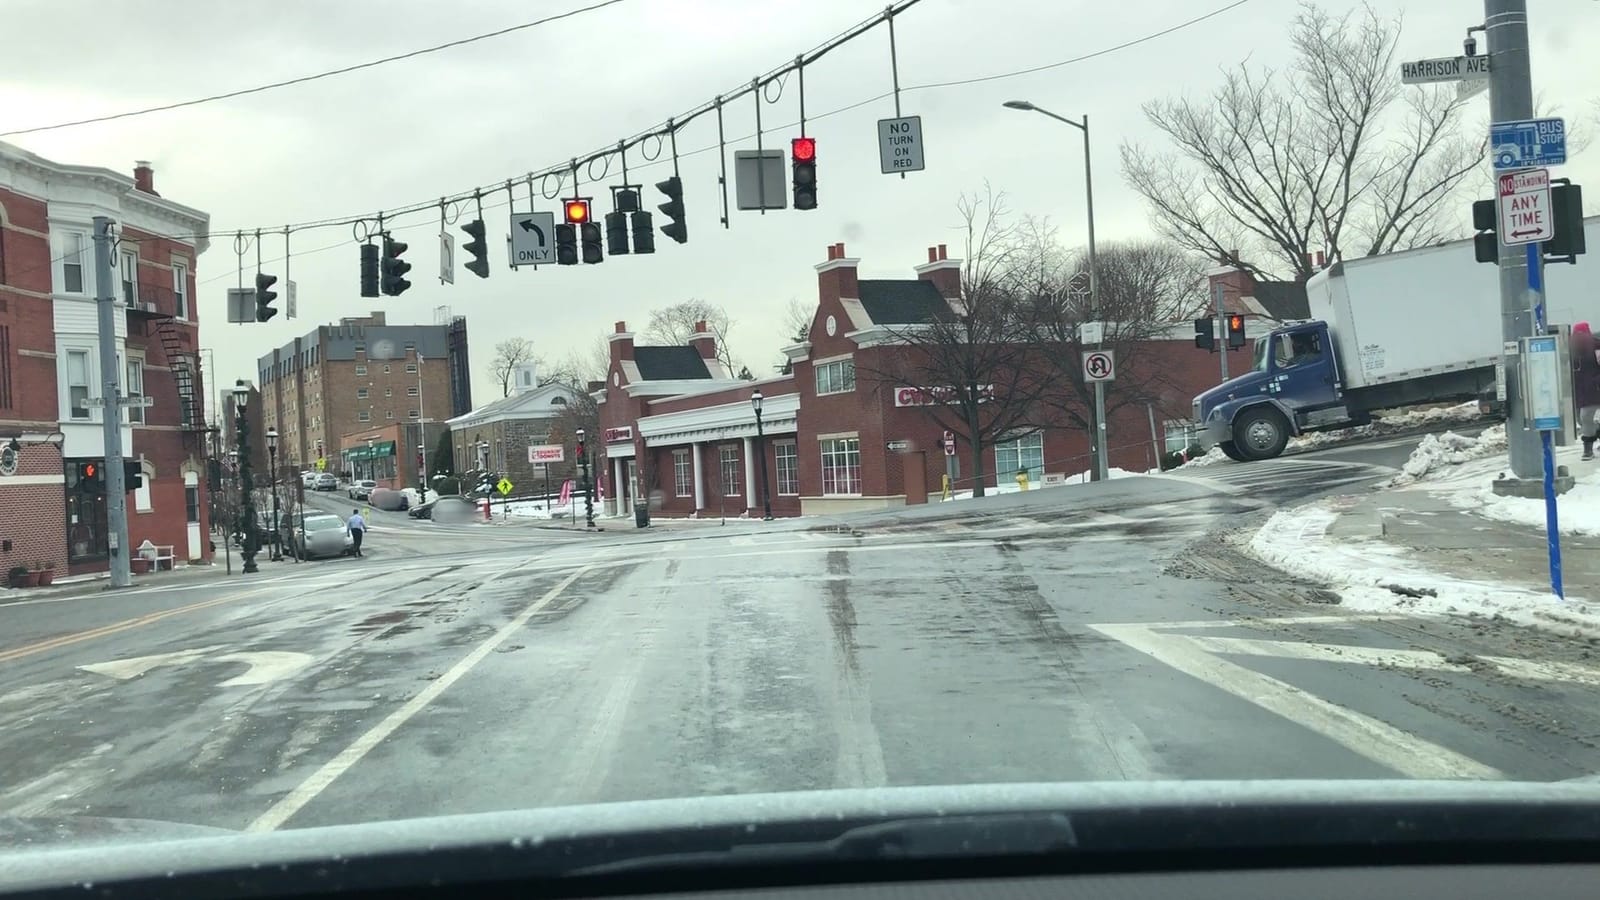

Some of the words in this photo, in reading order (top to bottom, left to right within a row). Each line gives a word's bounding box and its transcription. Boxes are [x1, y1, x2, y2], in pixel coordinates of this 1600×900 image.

[1402, 60, 1460, 78] HARRISON
[1466, 58, 1488, 73] AVE
[890, 122, 910, 134] NO
[1539, 121, 1562, 134] BUS
[888, 135, 913, 146] TURN
[1540, 133, 1563, 145] STOP
[894, 147, 909, 157] ON
[893, 158, 912, 168] RED
[1500, 178, 1514, 193] NO
[1515, 175, 1546, 190] STANDING
[1511, 195, 1539, 211] ANY
[1510, 211, 1543, 227] TIME
[519, 250, 548, 261] ONLY
